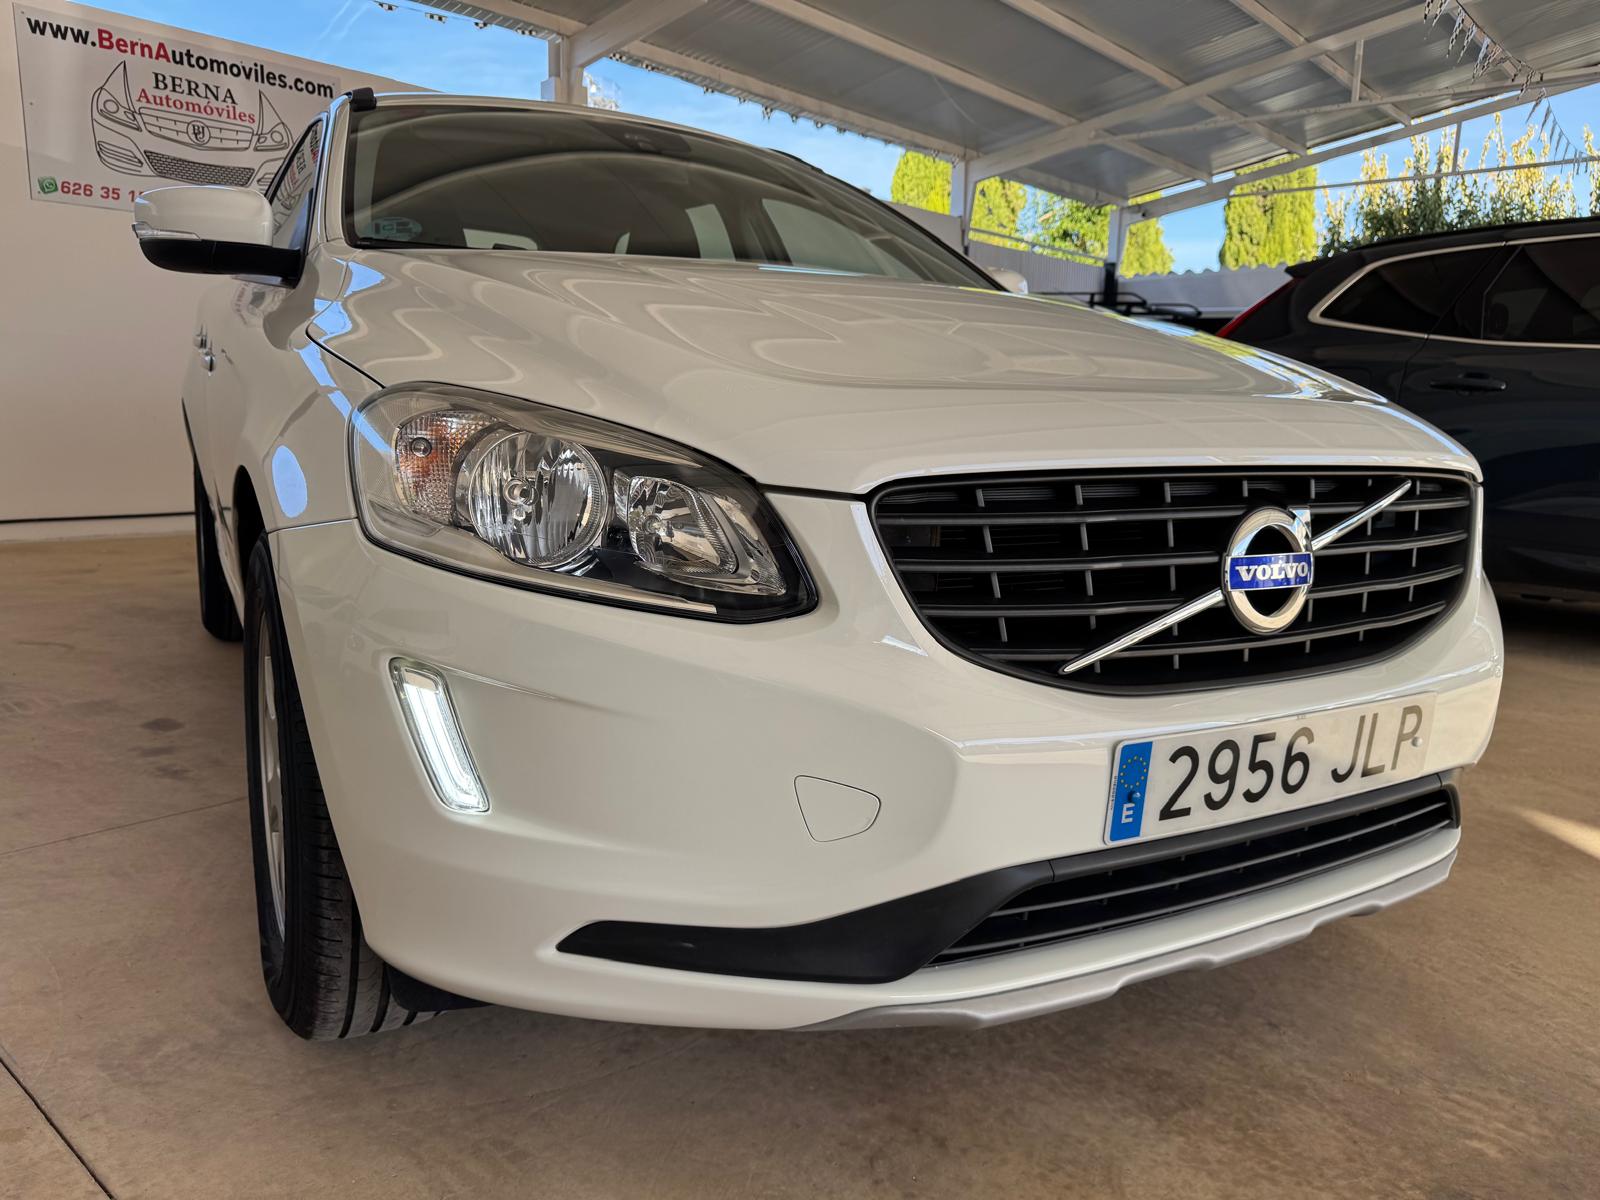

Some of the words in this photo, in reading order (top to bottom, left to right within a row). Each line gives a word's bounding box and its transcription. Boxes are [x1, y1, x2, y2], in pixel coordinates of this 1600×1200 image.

[26, 16, 335, 99] www.BernAutomoviles.com
[136, 87, 256, 124] Automóviles
[152, 71, 239, 106] BERNA
[61, 180, 94, 198] 626
[100, 186, 120, 201] 35
[128, 190, 145, 203] 1
[1235, 561, 1308, 582] VOLVO
[1158, 726, 1315, 822] 2956
[1331, 704, 1424, 784] JLP
[1121, 802, 1136, 824] E
